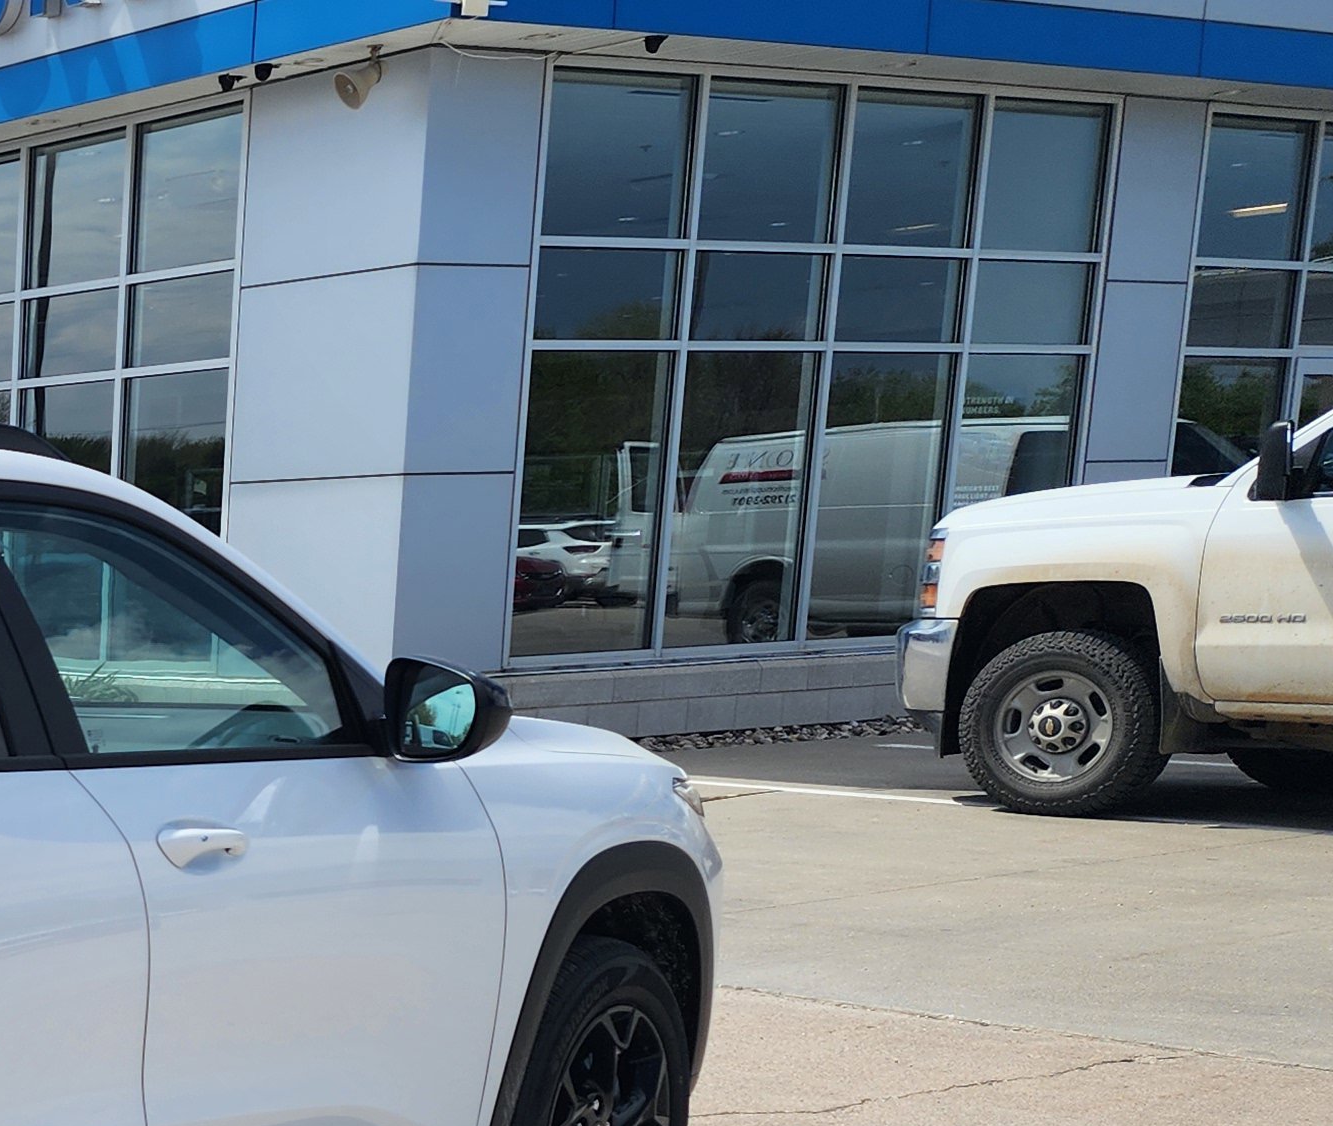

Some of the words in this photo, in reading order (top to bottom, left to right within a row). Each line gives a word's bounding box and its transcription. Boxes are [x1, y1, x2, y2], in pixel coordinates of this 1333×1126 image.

[965, 396, 1004, 405] TRENGTH
[1219, 615, 1273, 624] 2500
[1276, 614, 1307, 624] HD
